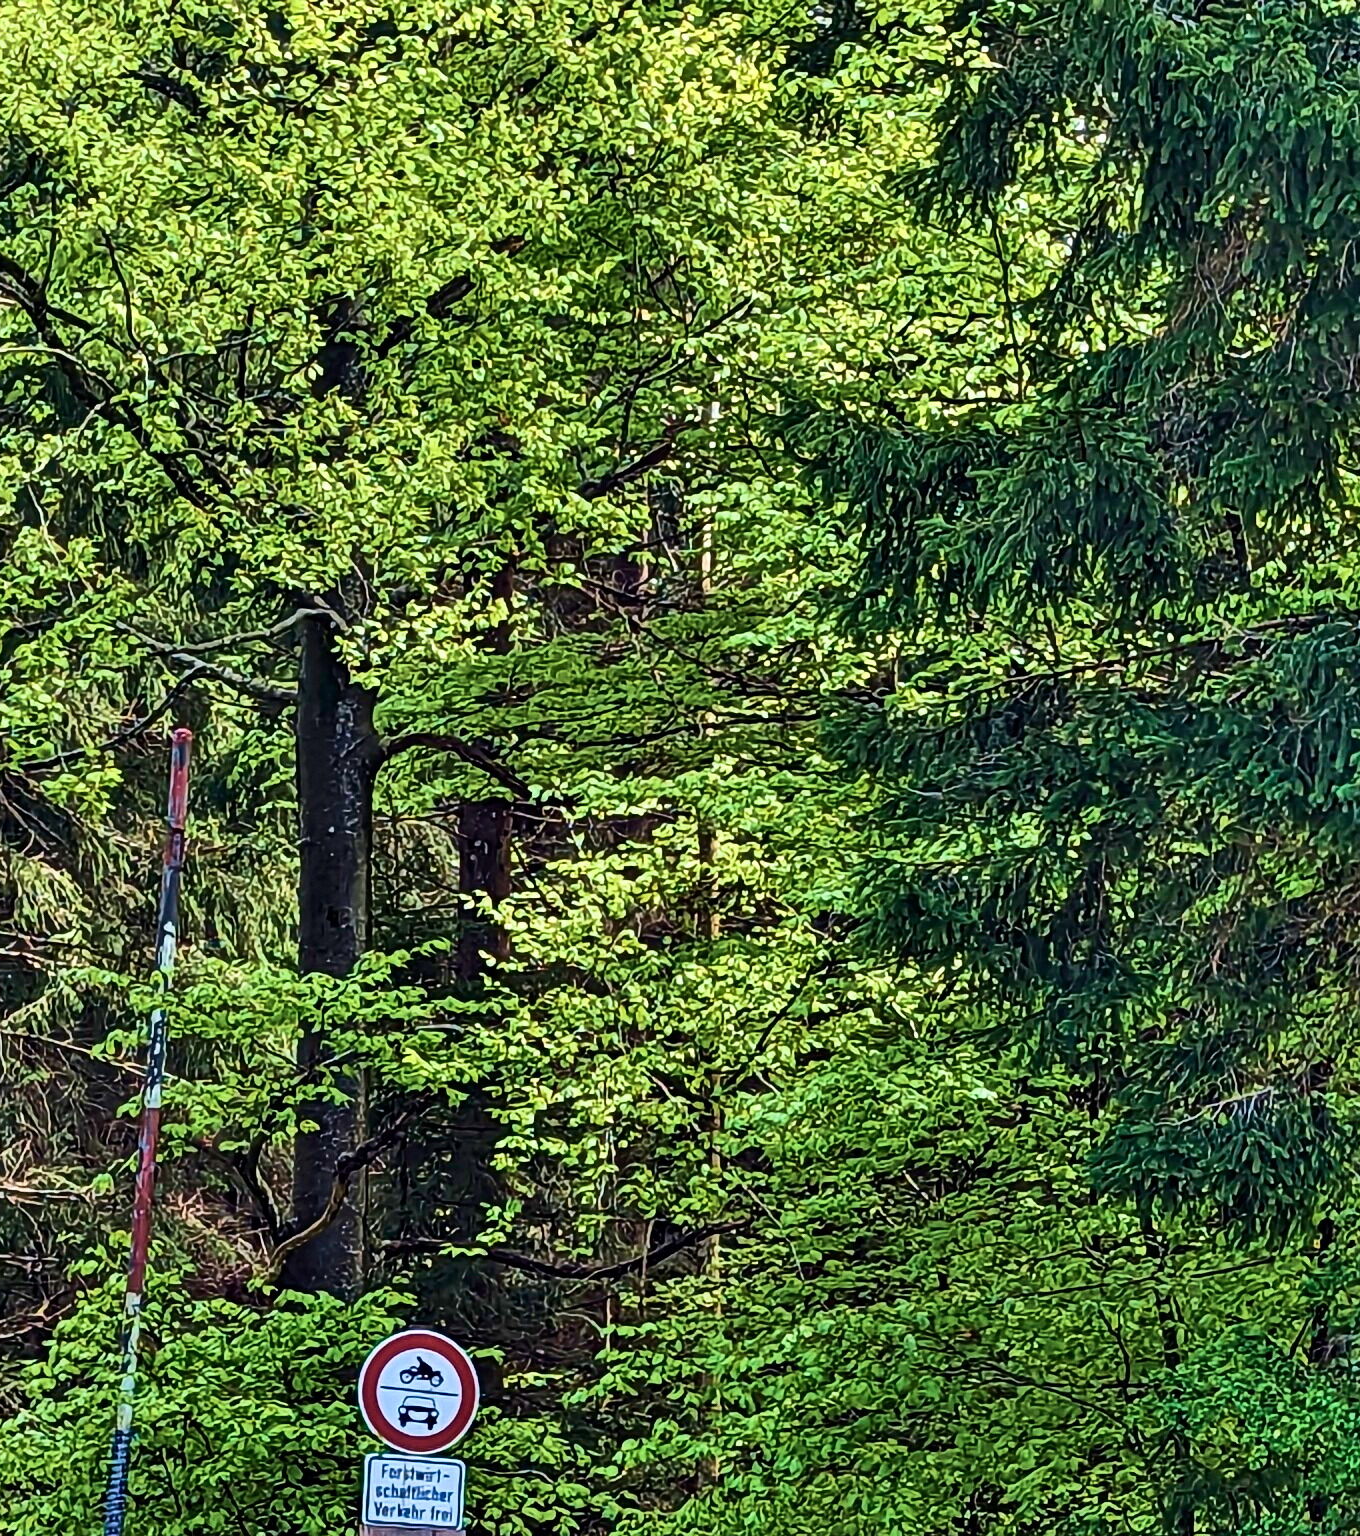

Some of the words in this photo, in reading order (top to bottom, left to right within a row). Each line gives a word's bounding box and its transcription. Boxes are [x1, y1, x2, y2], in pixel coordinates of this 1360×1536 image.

[381, 1463, 450, 1483] Forstwirt-
[375, 1483, 454, 1503] schaftlicher
[374, 1501, 426, 1520] Verkehr
[431, 1505, 453, 1522] frei
